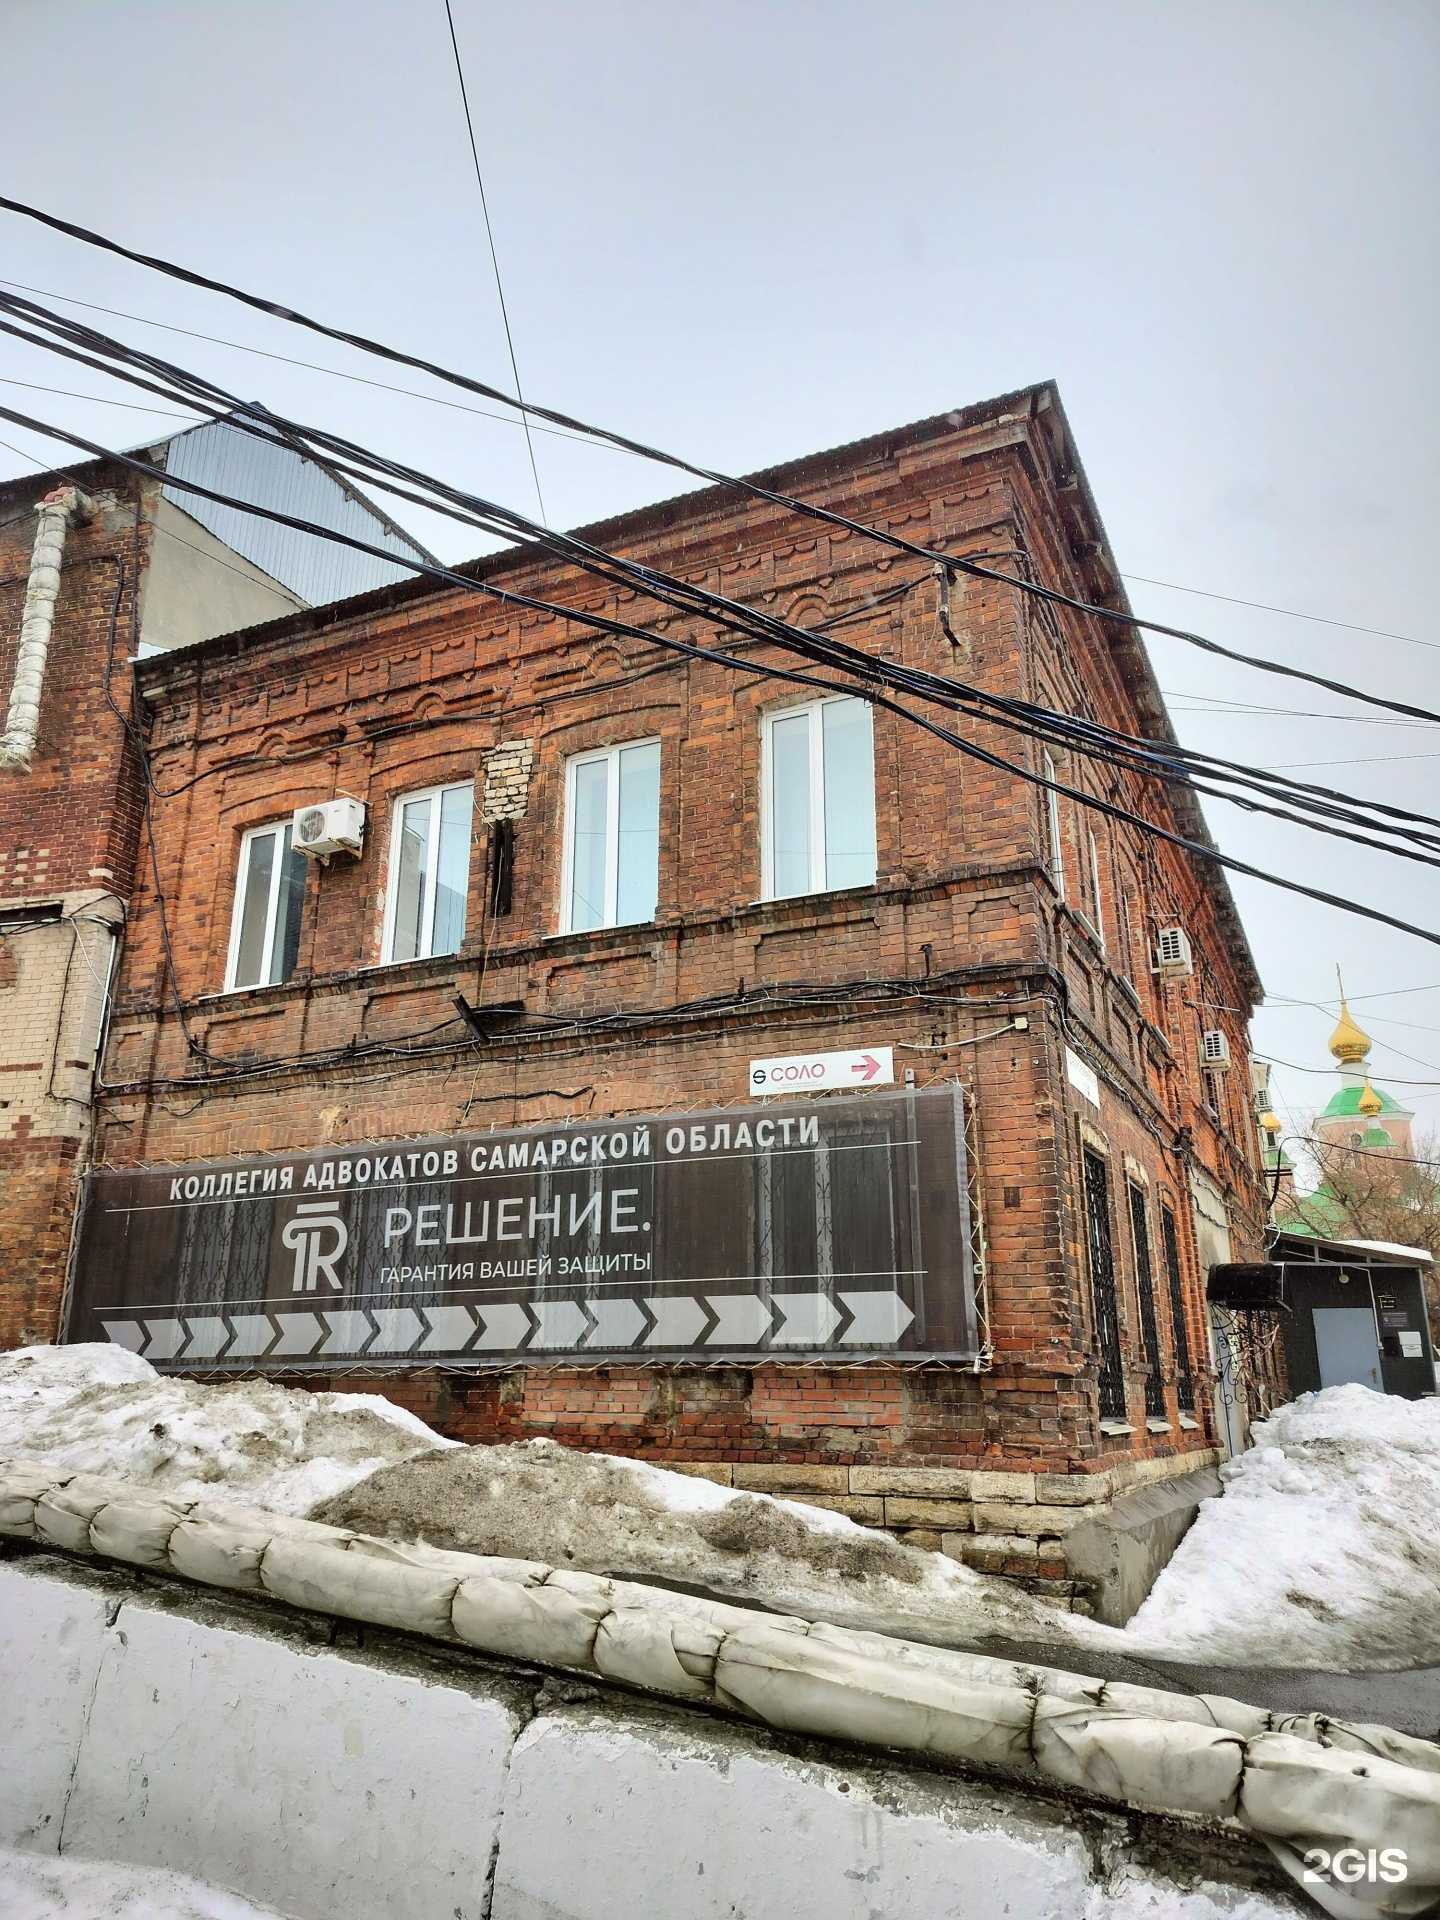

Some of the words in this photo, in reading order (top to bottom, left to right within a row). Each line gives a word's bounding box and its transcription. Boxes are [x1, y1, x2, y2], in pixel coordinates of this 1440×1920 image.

[170, 1166, 294, 1200] КОЛЛЕГИЯ
[303, 1150, 459, 1190] АДВОКАТОВ
[470, 1125, 650, 1171] САМАРСКОЙ
[666, 1116, 819, 1154] ОБЛАСТИ
[384, 1188, 651, 1249] РЕШЕНИЕ.
[380, 1262, 474, 1284] ГАРАНТИЯ
[479, 1254, 552, 1279] ВАШЕЙ
[558, 1253, 651, 1275] ЗАЩИТЫ
